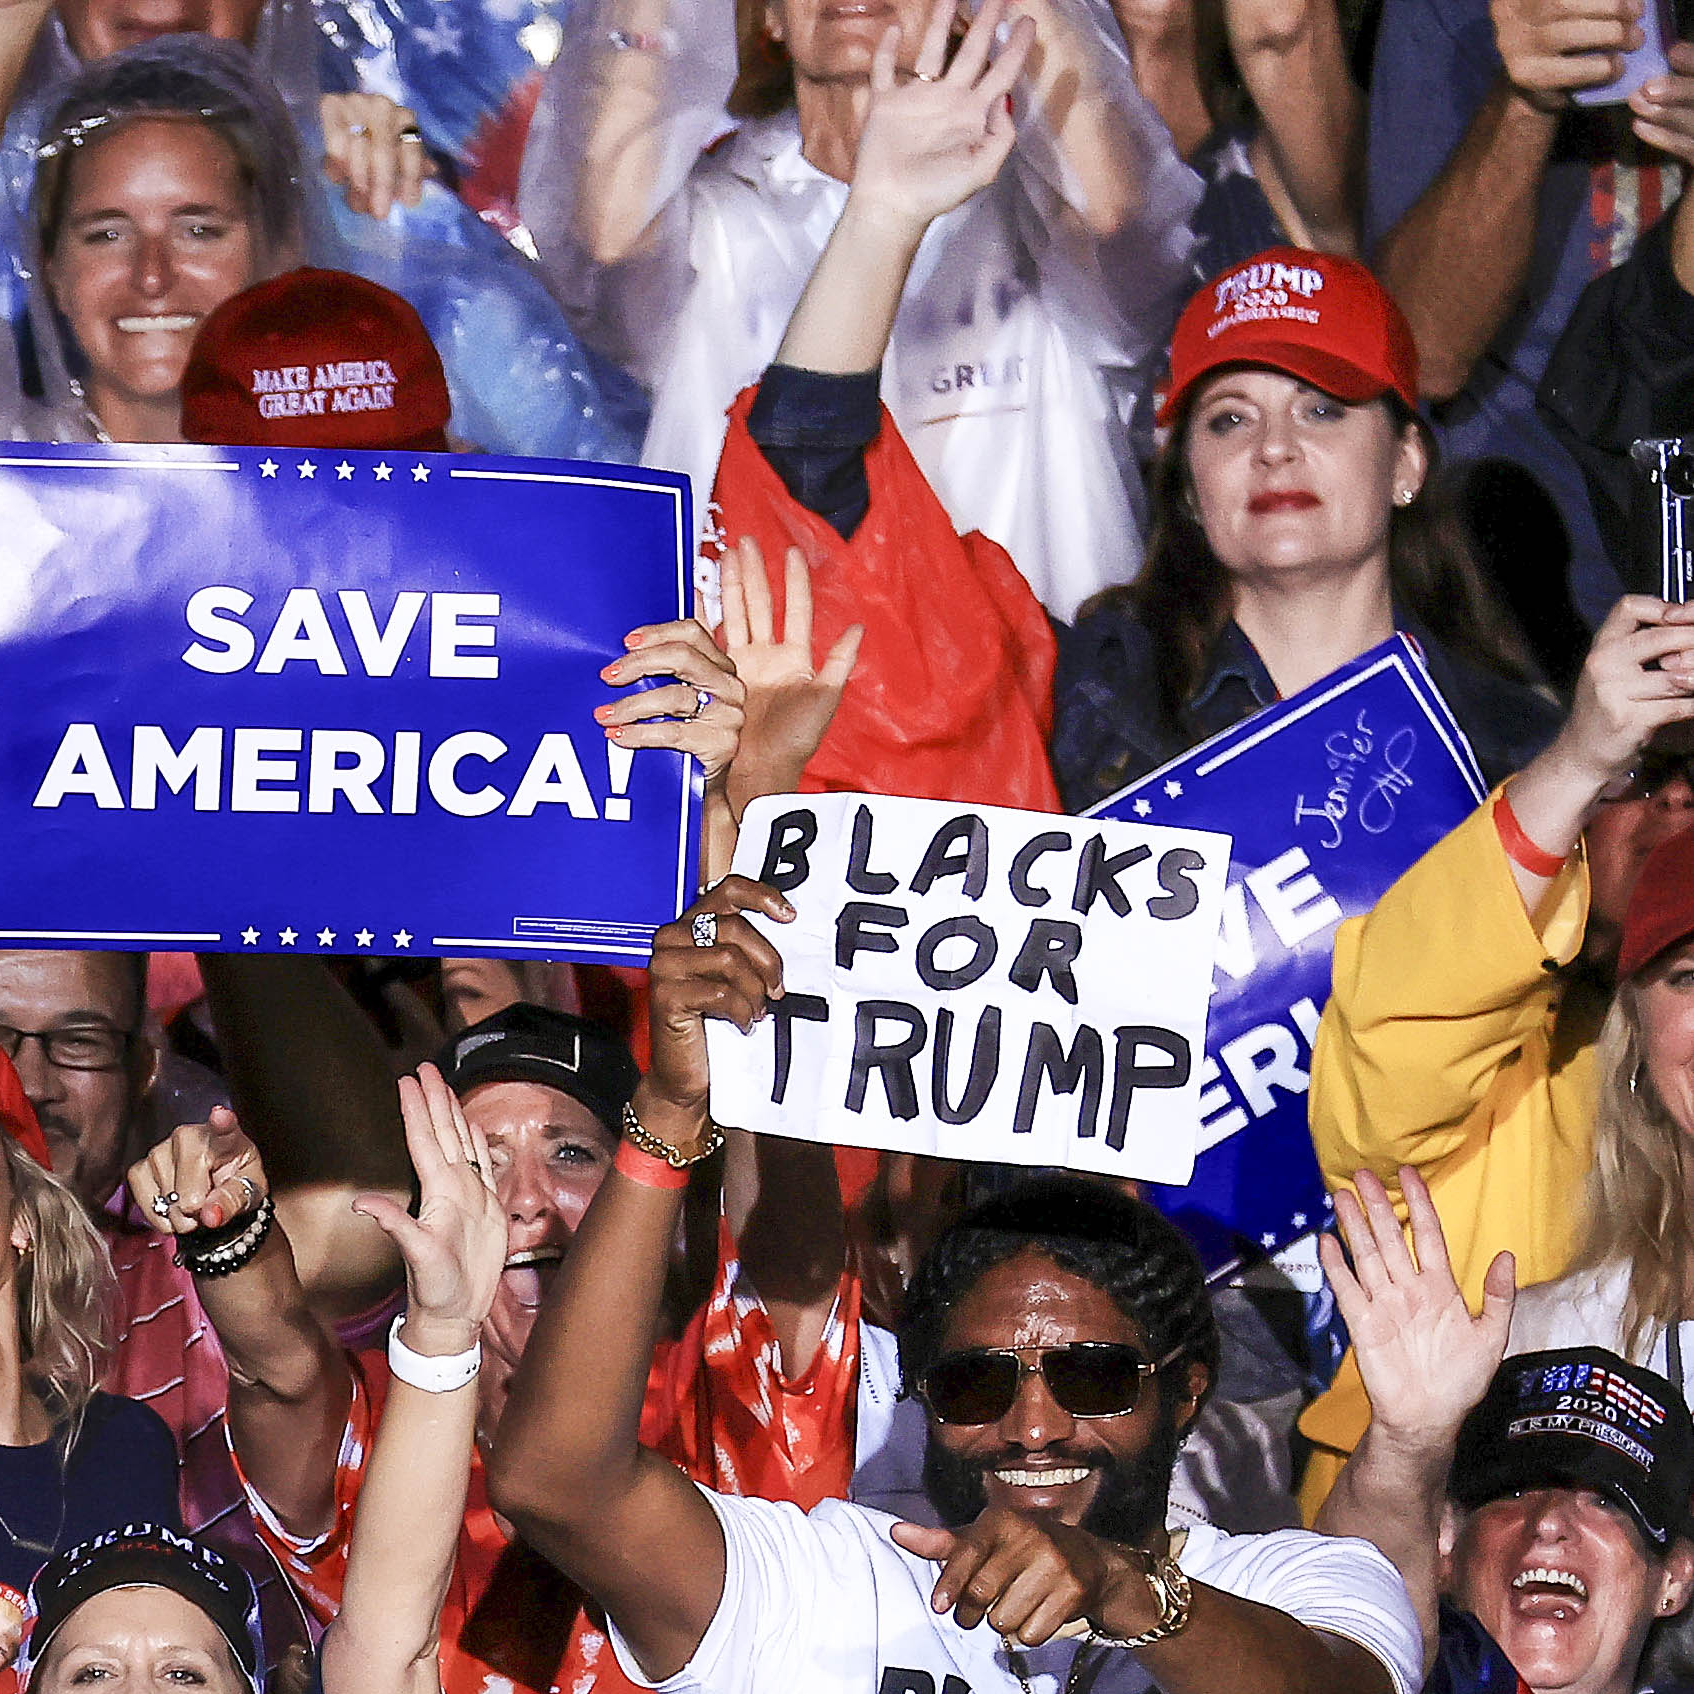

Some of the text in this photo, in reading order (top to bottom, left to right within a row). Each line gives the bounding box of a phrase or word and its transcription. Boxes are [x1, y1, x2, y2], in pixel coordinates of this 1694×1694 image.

[1215, 263, 1324, 312] TRUMP
[252, 360, 398, 394] MAKE AMERICA
[259, 387, 395, 420] GREAT AGAIN
[182, 586, 500, 679] SAVE
[32, 723, 635, 822] AMERICA!
[763, 802, 1207, 924] BLACKS
[1215, 845, 1344, 980] VE
[834, 900, 1083, 1005] FOR
[766, 991, 1191, 1152] TRUMP
[1548, 1415, 1574, 1429] MY
[1578, 1421, 1656, 1468] PRESIDENT
[1556, 1394, 1617, 1422] 2020
[65, 1523, 225, 1567] TRUMP
